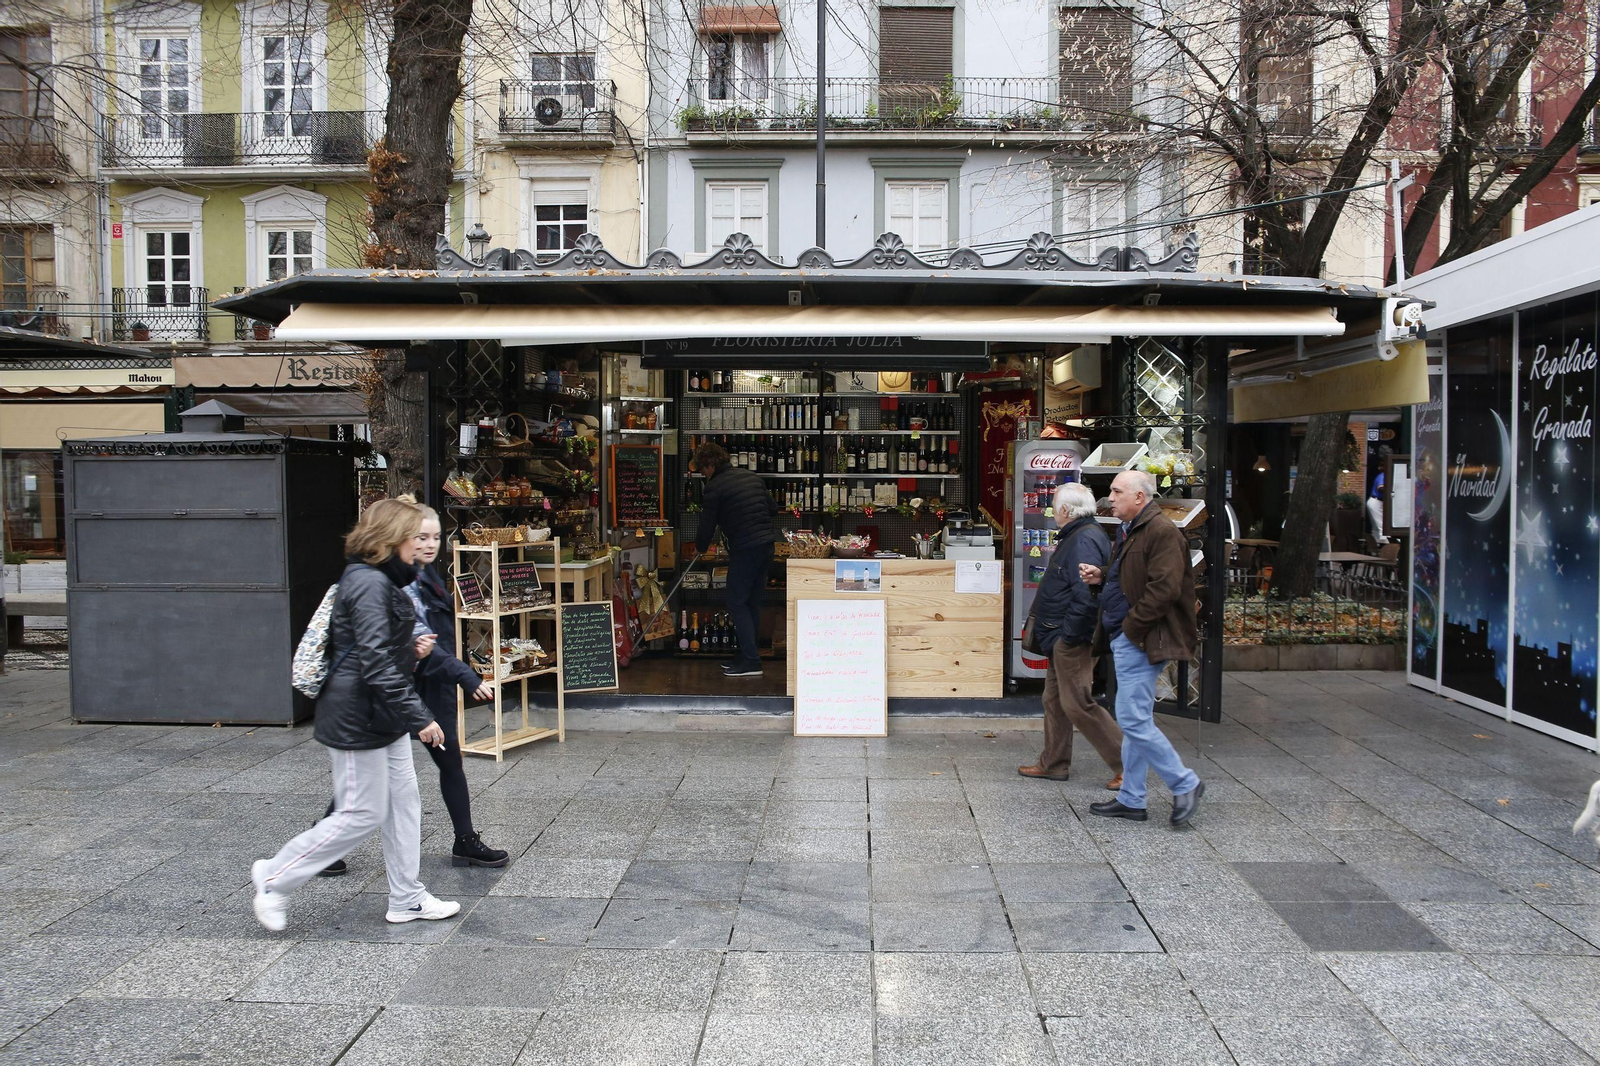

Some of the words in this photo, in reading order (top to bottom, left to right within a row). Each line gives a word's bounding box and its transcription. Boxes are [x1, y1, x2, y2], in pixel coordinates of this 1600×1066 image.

[680, 341, 688, 350] 19
[1530, 338, 1598, 390] Regálate
[128, 374, 162, 382] Mahou
[1044, 403, 1079, 418] Productos
[1532, 406, 1592, 451] Granada
[1448, 464, 1500, 498] Navidad
